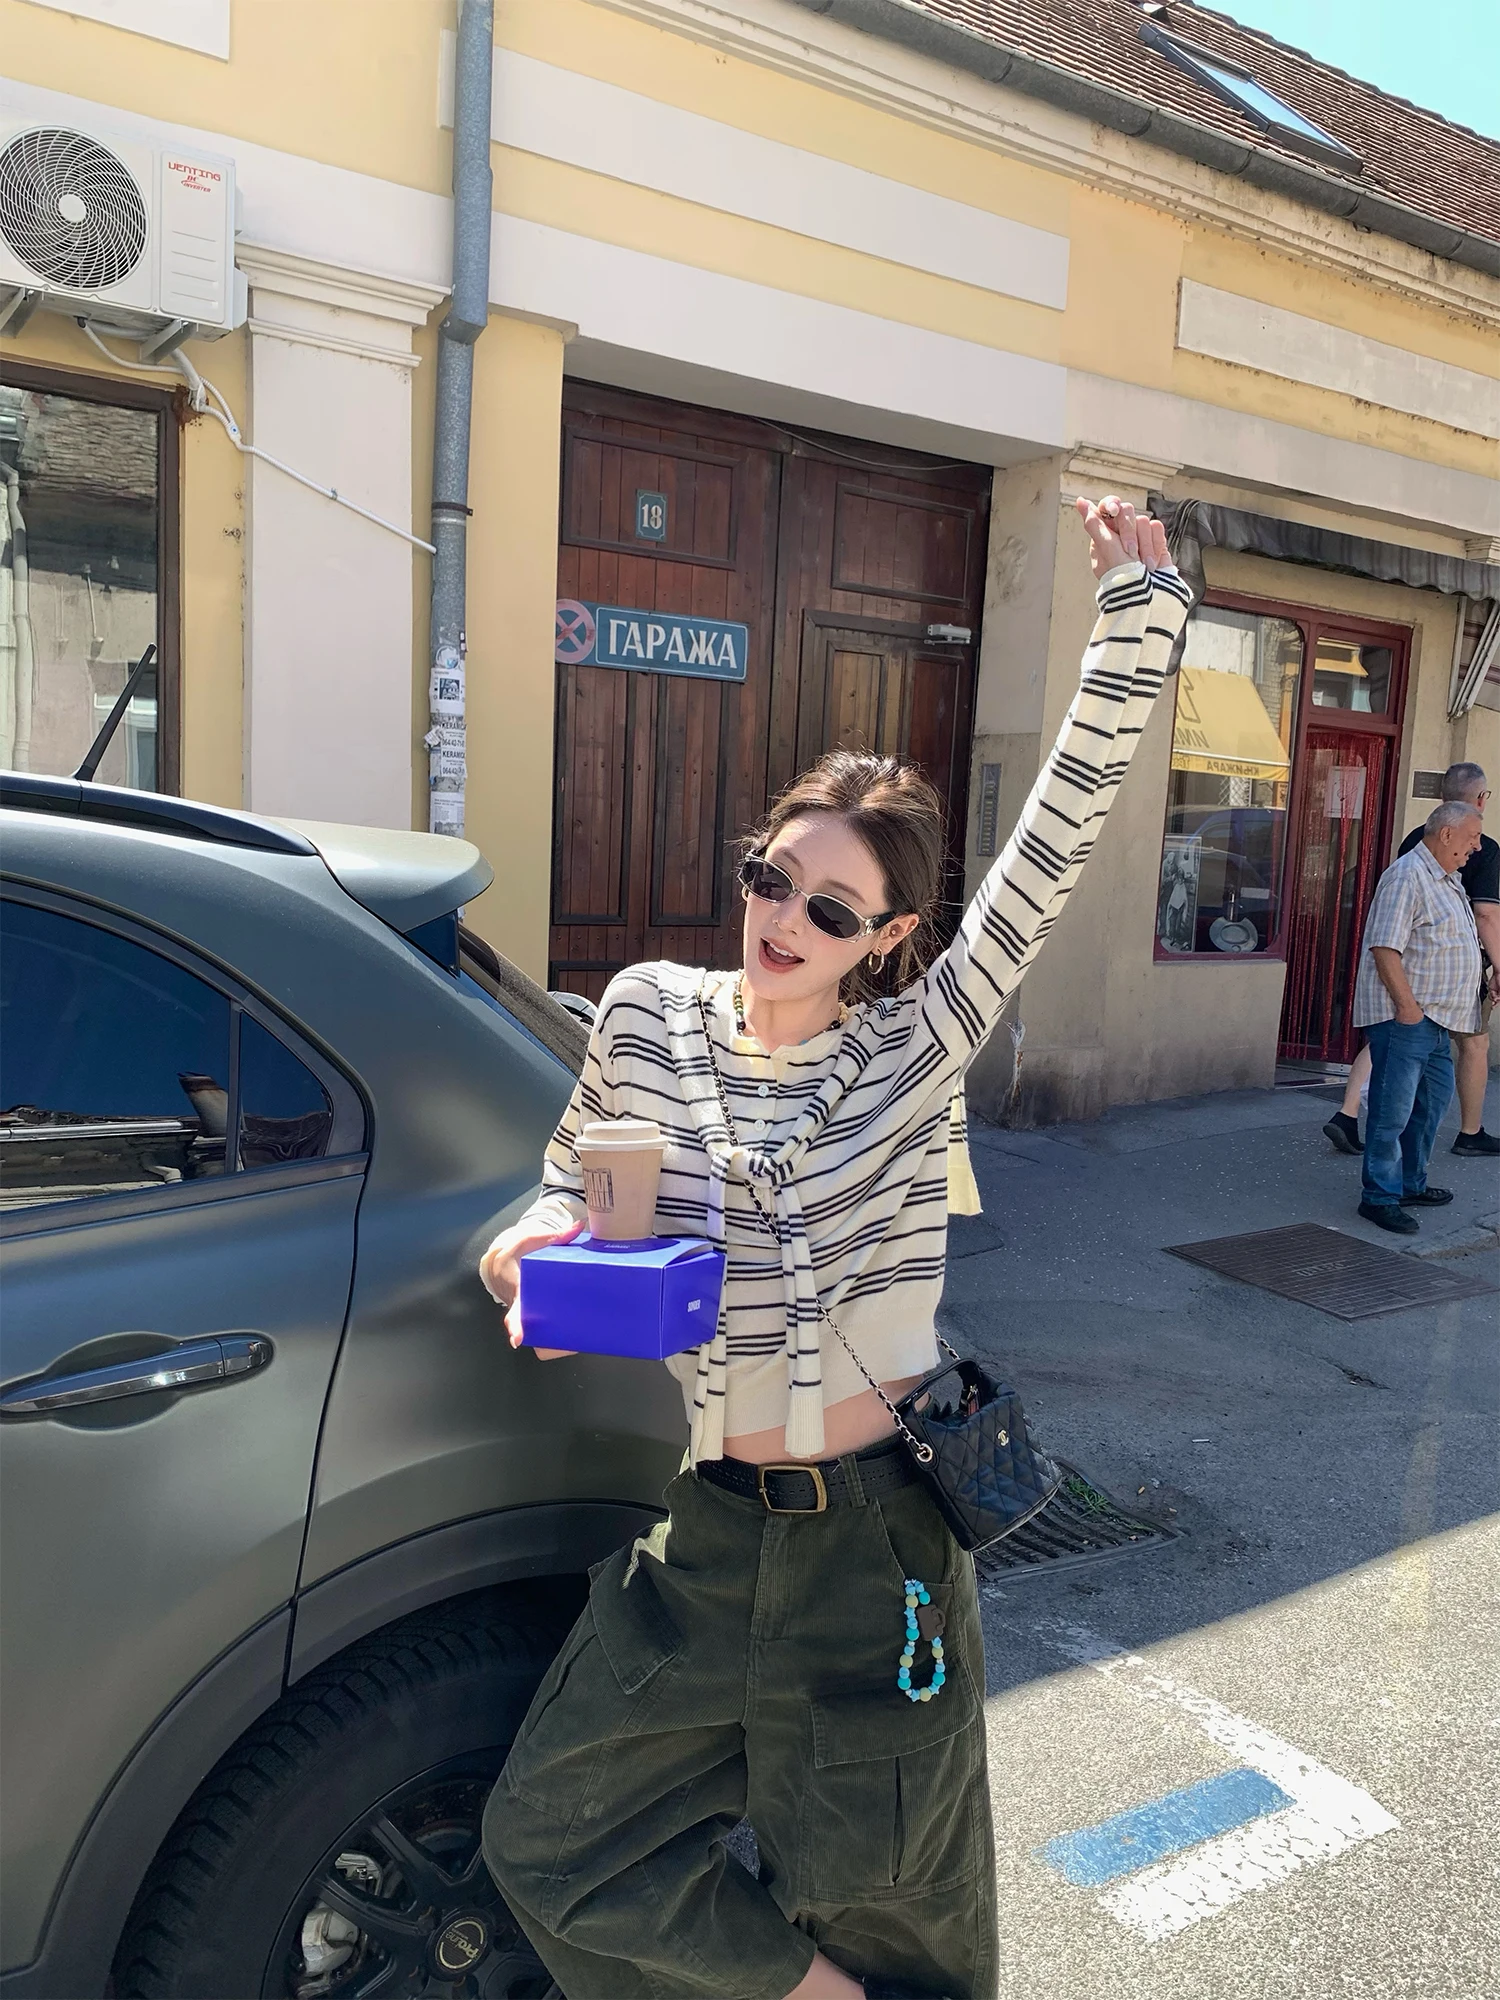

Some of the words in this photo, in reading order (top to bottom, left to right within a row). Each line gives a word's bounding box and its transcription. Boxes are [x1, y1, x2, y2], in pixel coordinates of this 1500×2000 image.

[183, 183, 211, 193] INVERTER
[641, 503, 663, 530] 18
[608, 618, 738, 669] ГАРАЖА
